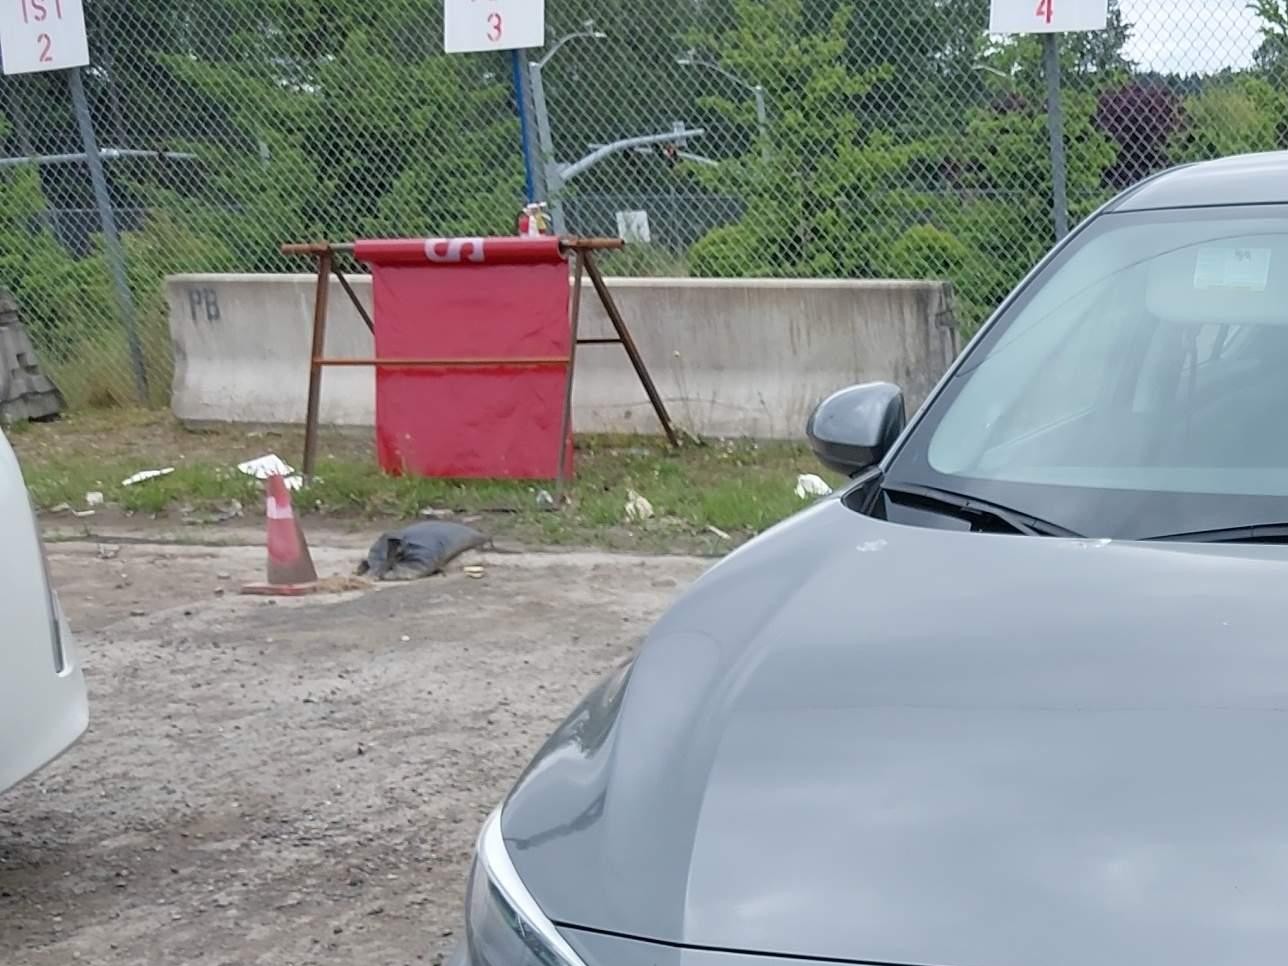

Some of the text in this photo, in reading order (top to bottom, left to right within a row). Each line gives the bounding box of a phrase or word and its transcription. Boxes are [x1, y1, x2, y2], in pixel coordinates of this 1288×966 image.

[1036, 0, 1053, 23] 4
[487, 13, 502, 41] 3
[37, 33, 53, 62] 2
[188, 287, 220, 325] PB
